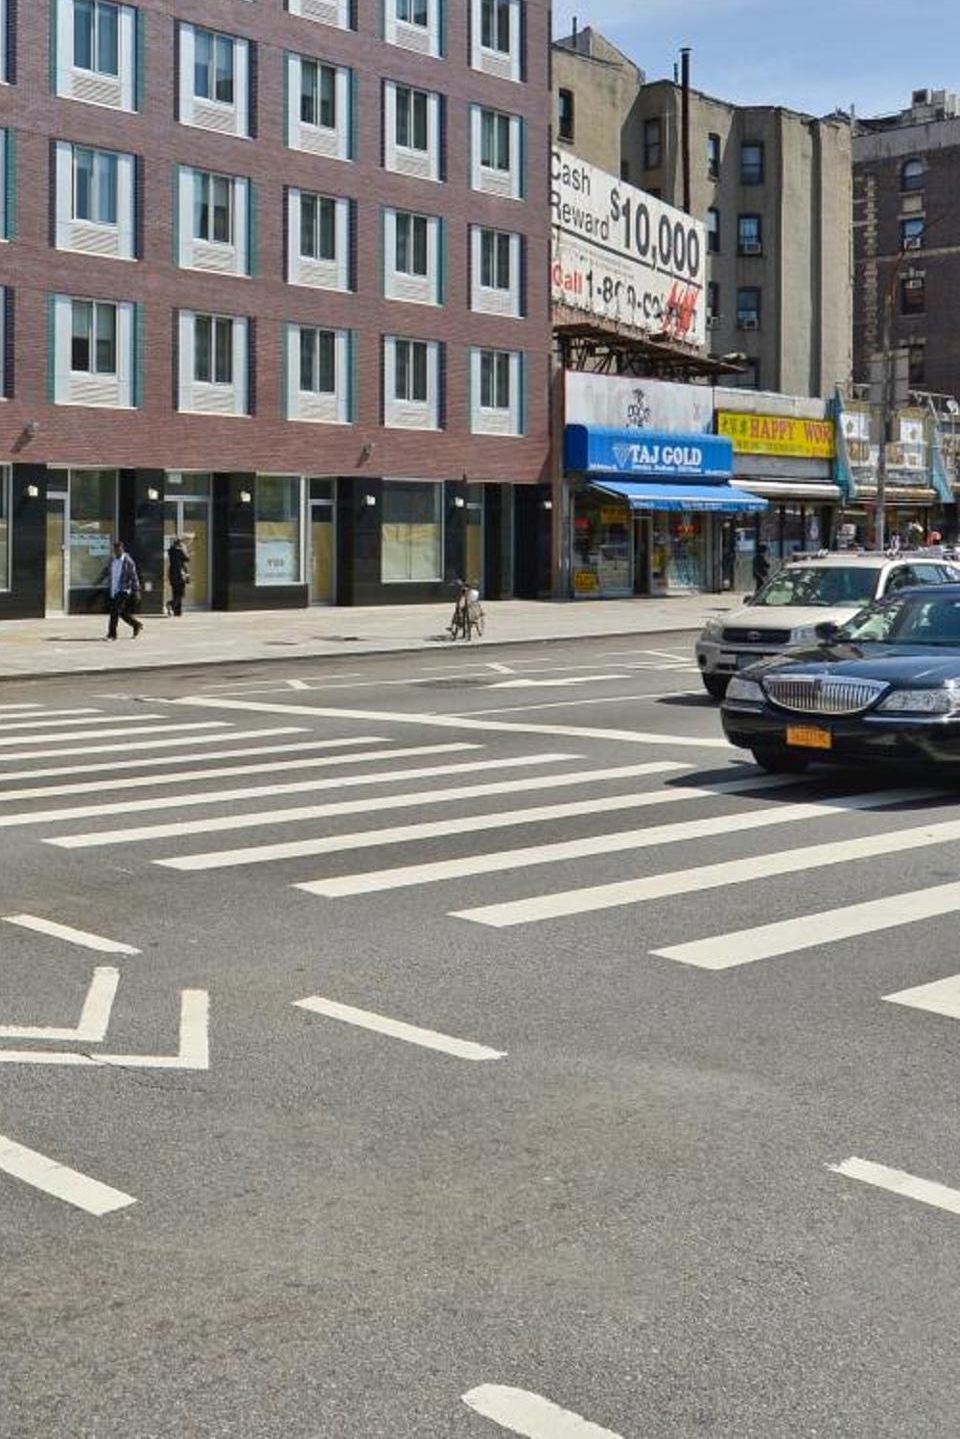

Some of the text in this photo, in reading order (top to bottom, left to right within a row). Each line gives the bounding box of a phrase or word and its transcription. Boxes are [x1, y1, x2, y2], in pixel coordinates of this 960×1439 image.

[551, 151, 591, 196] Cash
[551, 190, 610, 241] Reward
[610, 187, 700, 278] $10,000
[750, 418, 796, 441] HAPPY
[631, 443, 702, 466] TAJ GOLD
